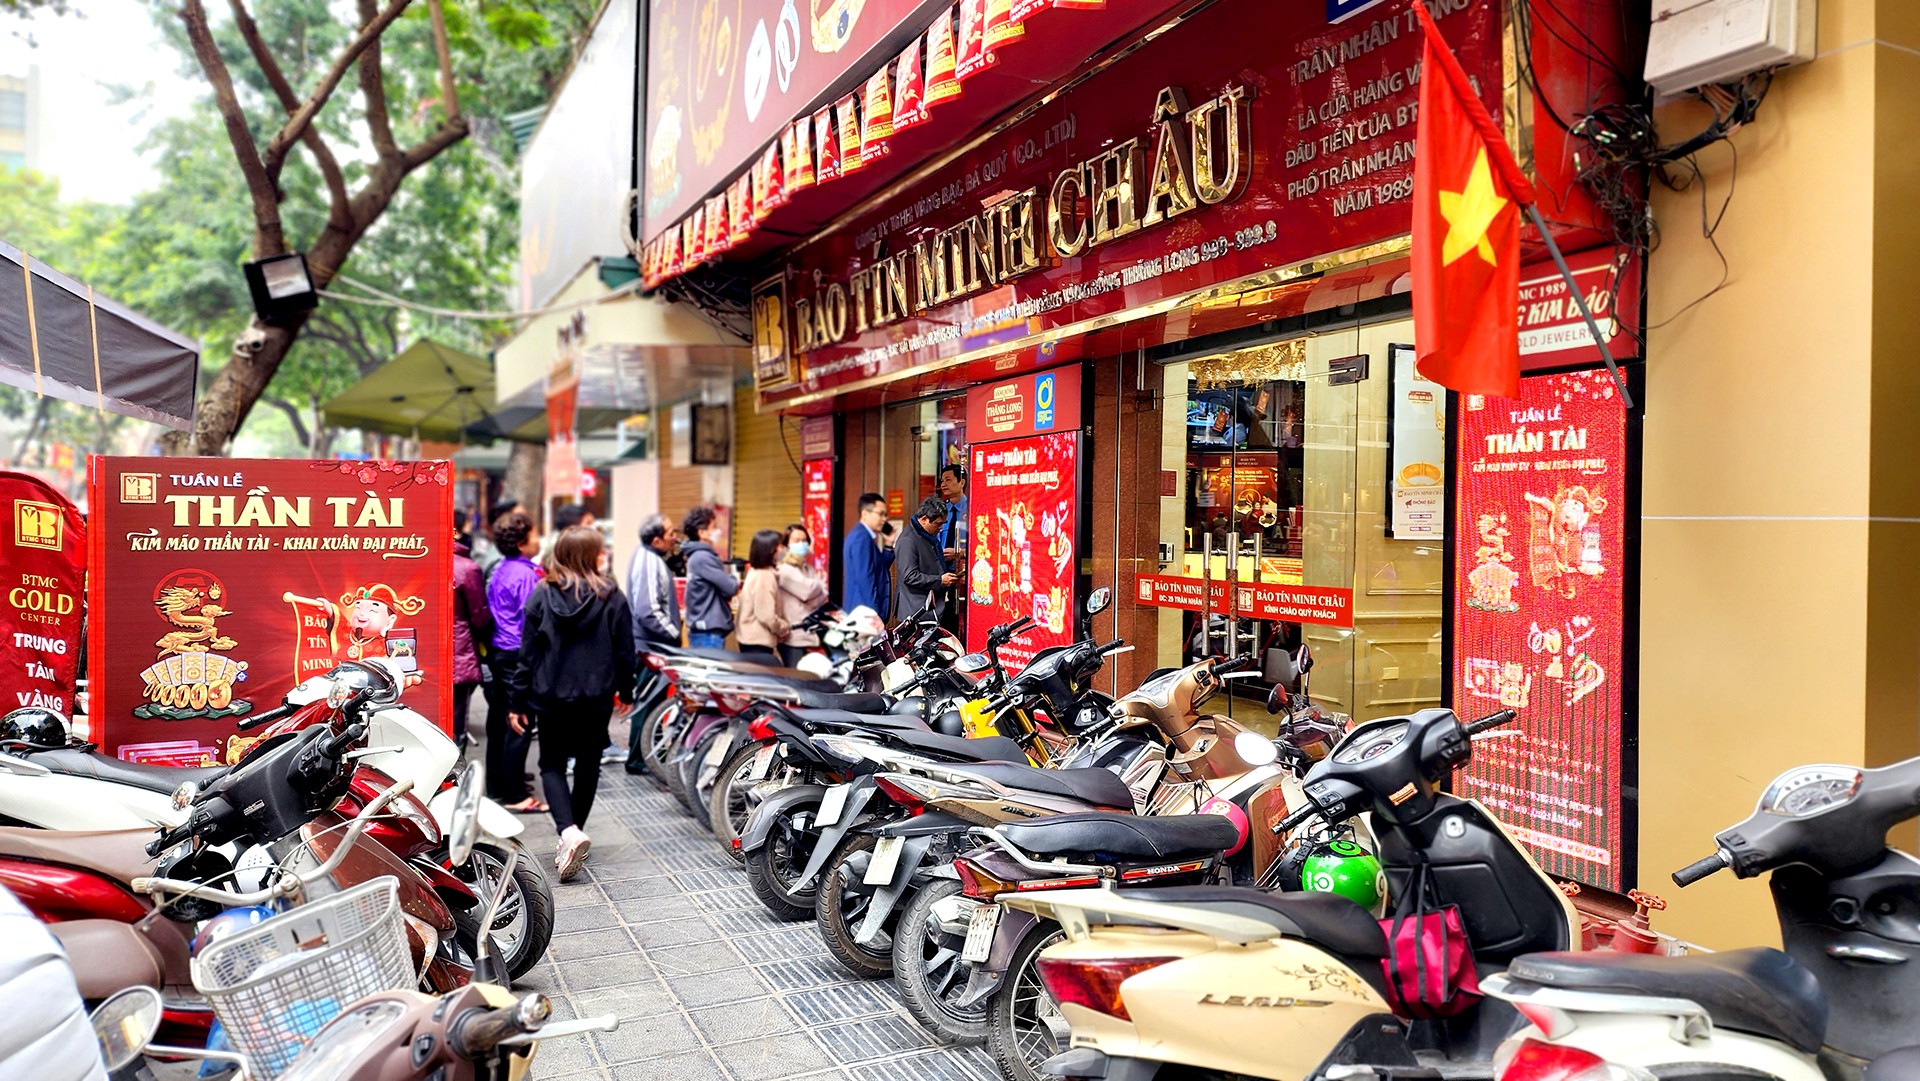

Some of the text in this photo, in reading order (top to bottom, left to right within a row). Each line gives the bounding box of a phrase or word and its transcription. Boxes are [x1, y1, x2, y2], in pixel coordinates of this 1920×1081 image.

[1340, 15, 1400, 63] NHÂN
[1298, 107, 1317, 130] LÀ
[1319, 93, 1351, 121] CỬA
[1353, 72, 1404, 108] HÀNG
[1285, 140, 1317, 168] ĐẦU
[1319, 126, 1355, 155] TIÊN
[1357, 112, 1393, 141] CỦA
[1288, 138, 1416, 200] PHỐ TRẦN NHÂN
[1333, 175, 1414, 217] NĂM 1989
[795, 268, 847, 354] BẢO
[850, 239, 909, 334] TÍN
[913, 186, 1040, 312] MINH
[1048, 85, 1249, 259] CHÂU
[1121, 258, 1164, 286] THĂNG
[1539, 281, 1567, 298] 1989
[1527, 298, 1563, 326] KIM
[987, 401, 1022, 417] THĂNG LONG
[1549, 425, 1587, 451] TÀI
[170, 471, 243, 487] TUẦN LỄ
[164, 485, 405, 528] THẦN TÀI
[128, 531, 162, 551] KIM
[165, 534, 200, 551] MÃO
[204, 531, 244, 551] THẦN
[246, 533, 271, 551] TÀI
[283, 537, 318, 551] KHAI
[321, 533, 359, 550] XUÂN
[363, 537, 387, 553] ĐẠI
[390, 533, 427, 553] PHÁT
[22, 573, 59, 589] BTMC
[1155, 580, 1169, 592] BẢO
[1170, 582, 1181, 593] TÍN
[1182, 584, 1202, 595] MINH
[9, 587, 74, 615] GOLD
[1256, 589, 1346, 608] BẢO TÍN MINH CHÂU
[20, 612, 61, 626] CENTER
[304, 614, 328, 629] BẢO
[1264, 604, 1337, 619] KÍNH CHÀO QUÝ KHÁCH
[13, 632, 67, 655] TRUNG
[307, 634, 327, 648] TÍN
[25, 661, 55, 681] TÂM
[302, 658, 333, 672] MINH
[16, 689, 63, 712] VÀNG
[1147, 865, 1181, 875] HONDA
[1198, 994, 1295, 1007] LEAD
